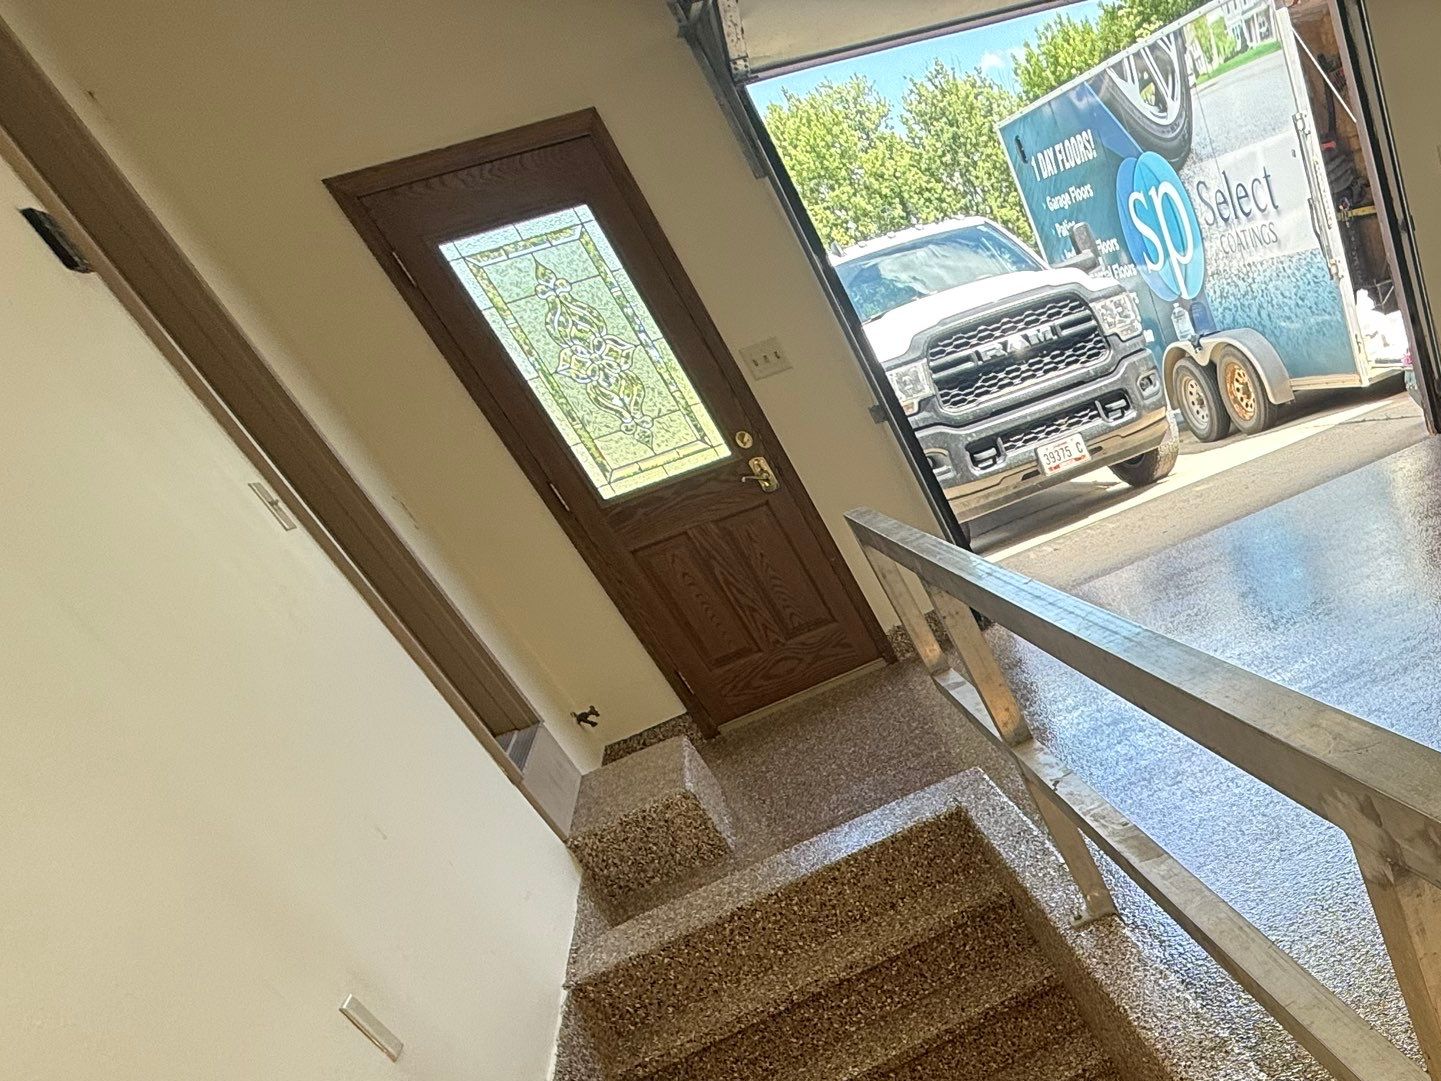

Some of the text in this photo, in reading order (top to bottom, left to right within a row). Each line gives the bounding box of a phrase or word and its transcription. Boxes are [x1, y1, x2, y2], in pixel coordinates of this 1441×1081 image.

[1031, 128, 1097, 182] 1 DAY FLOORS!
[1046, 183, 1094, 212] Garage Floors
[1196, 166, 1279, 226] Select
[1220, 221, 1279, 254] COATINGS
[1111, 263, 1138, 280] Floors
[980, 323, 1055, 362] RAM
[1043, 445, 1072, 465] 39375
[1075, 441, 1084, 453] C
